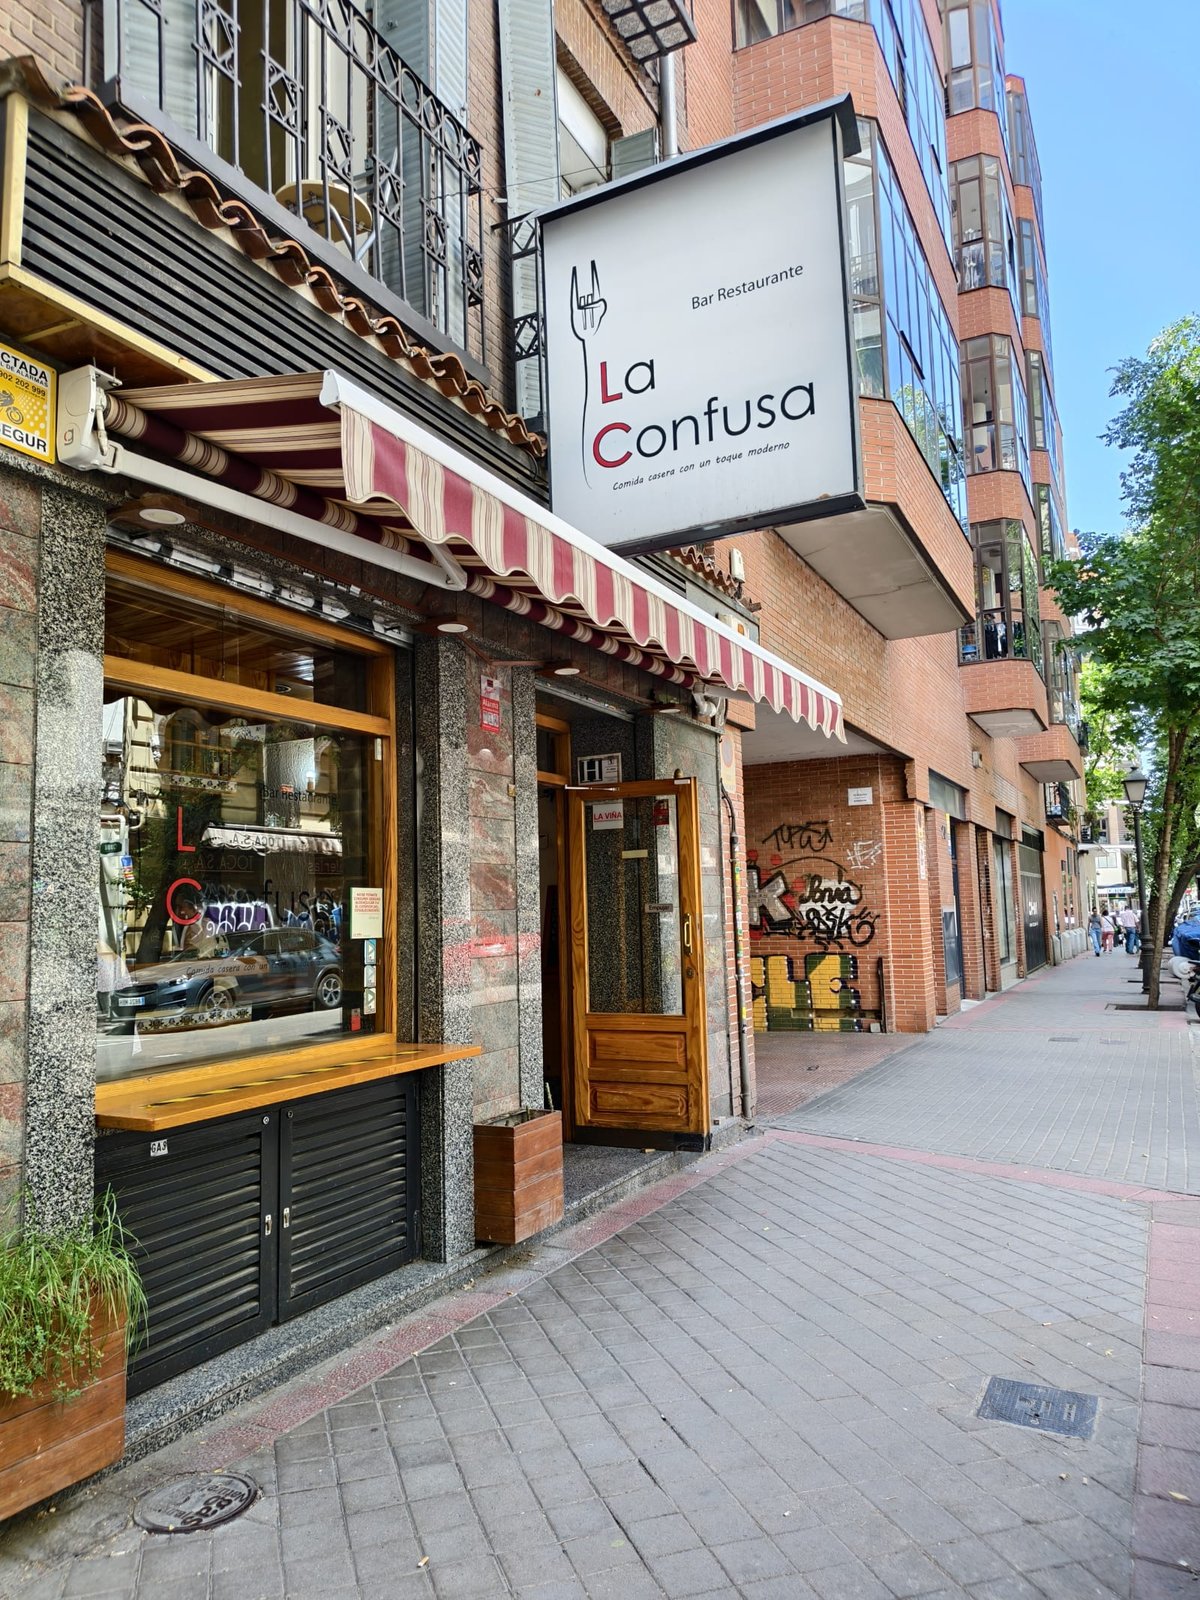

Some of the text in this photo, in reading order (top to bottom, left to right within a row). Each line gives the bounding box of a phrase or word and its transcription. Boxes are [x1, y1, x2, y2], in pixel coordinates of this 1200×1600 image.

[691, 264, 804, 310] Bar Restaurante
[1, 352, 48, 382] CTADA
[16, 369, 48, 388] ALARMAS
[600, 358, 655, 404] La
[15, 377, 30, 390] 202
[31, 385, 46, 397] 999
[2, 423, 47, 453] EGUR
[592, 382, 816, 468] Confusa
[612, 441, 790, 491] Comida casera con un toque moderno
[583, 759, 600, 781] H
[593, 810, 623, 821] LA VIÑA
[166, 877, 336, 926] Cfusa
[151, 1140, 168, 1153] GAS
